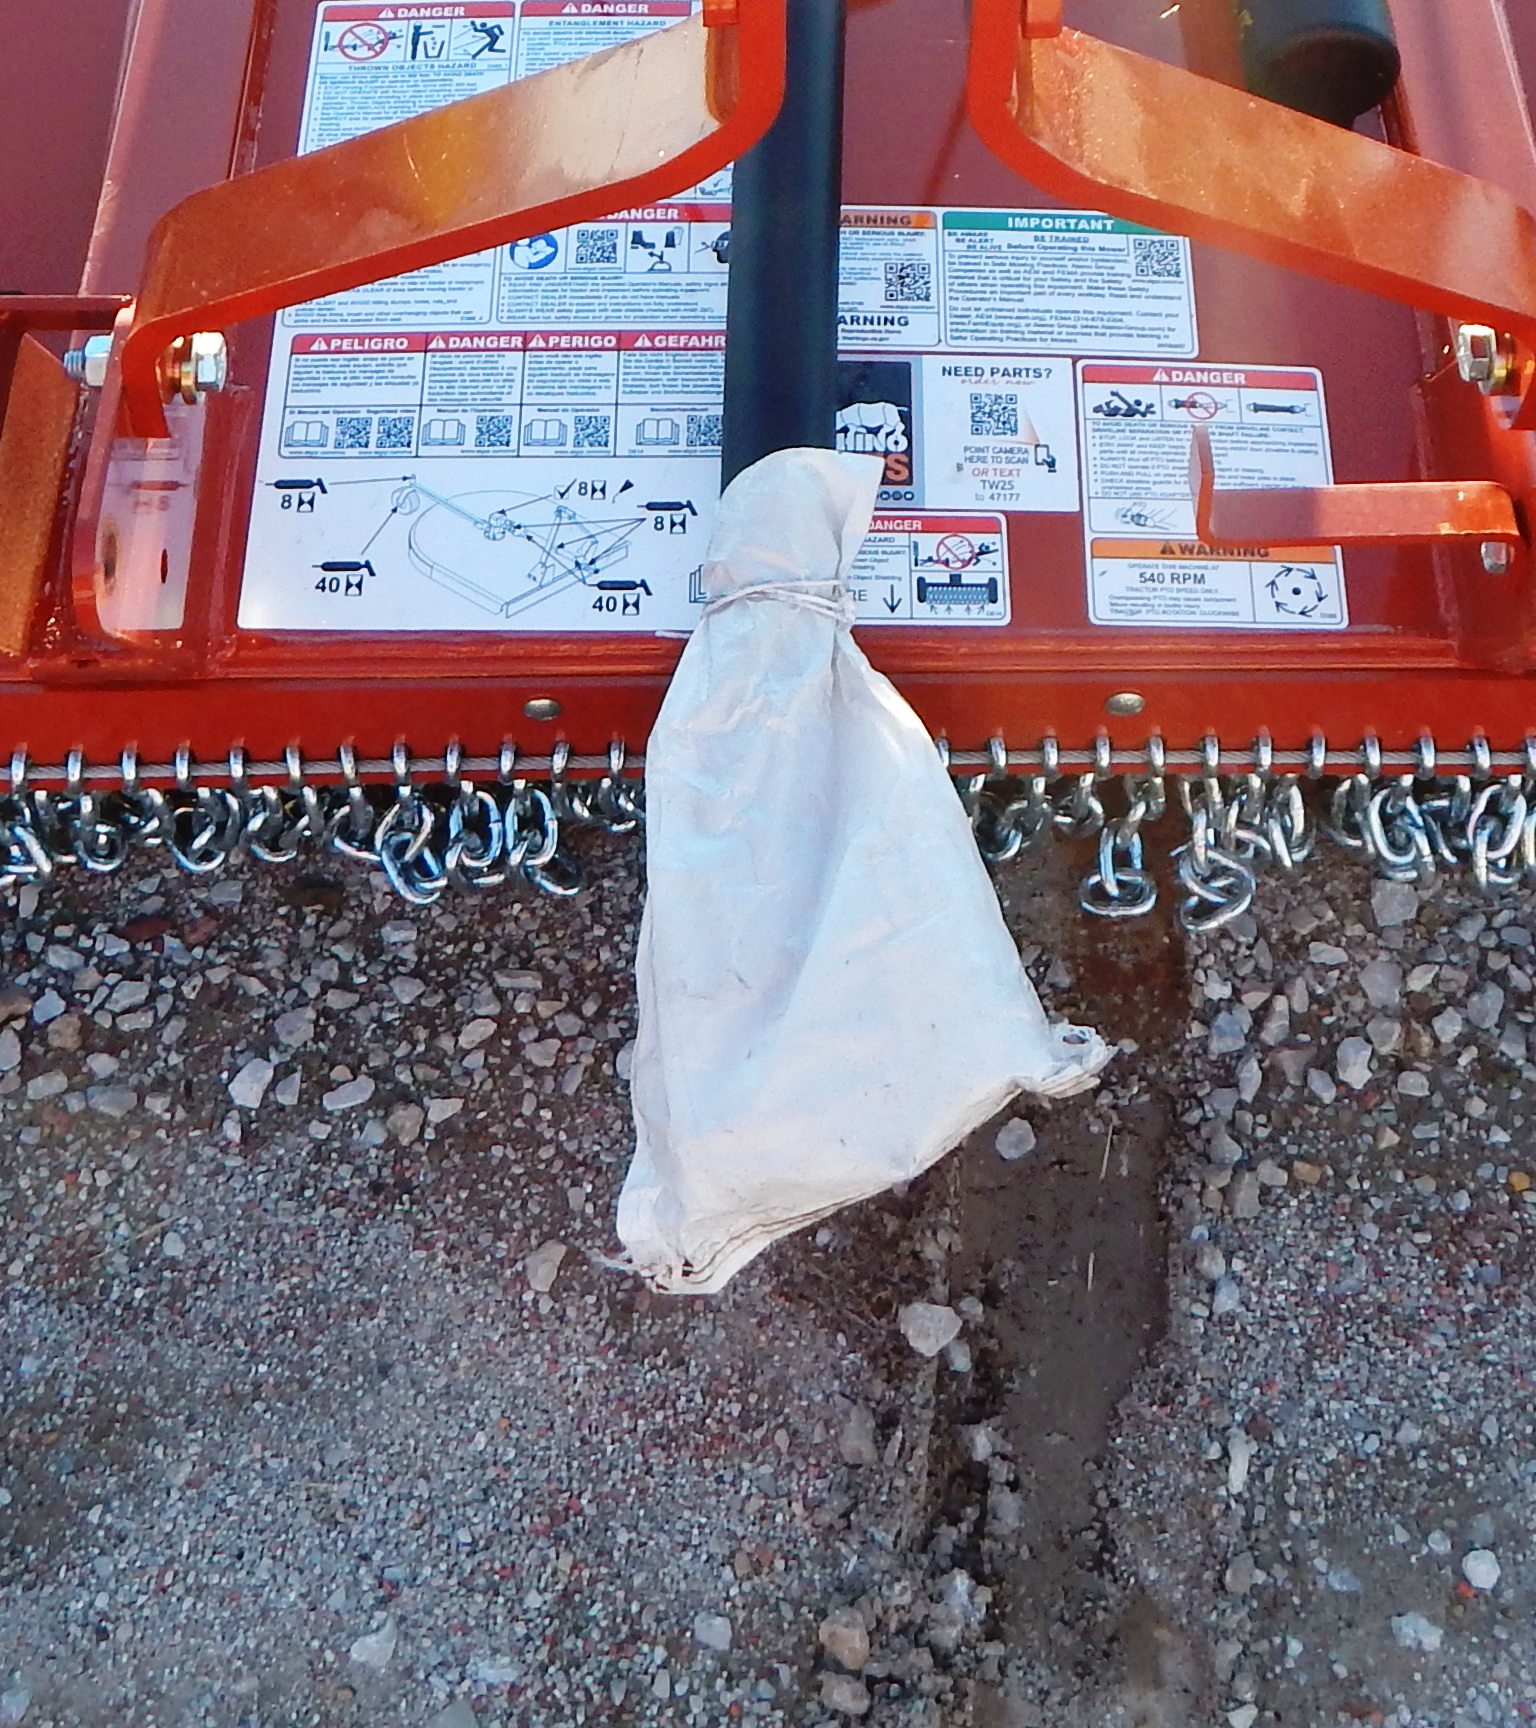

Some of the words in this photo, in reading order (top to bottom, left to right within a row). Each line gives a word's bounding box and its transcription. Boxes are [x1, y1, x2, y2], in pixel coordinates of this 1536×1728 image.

[397, 6, 465, 18] DANGER
[581, 3, 649, 14] DANGER
[840, 215, 912, 225] ARNING
[1008, 217, 1115, 230] IMPORTANT
[838, 314, 910, 326] ARNING
[330, 337, 409, 350] PELIGRO
[448, 336, 523, 348] DANGER
[548, 335, 617, 347] PERIGO
[654, 335, 726, 347] GEFAHR
[941, 365, 985, 377] NEED
[990, 367, 1053, 379] PARTS?
[1171, 370, 1246, 384] DANGER
[836, 432, 909, 452] HINO
[963, 445, 990, 454] POINT
[992, 446, 1029, 455] CAMERA
[964, 455, 987, 464] HERE
[991, 455, 1003, 464] TO
[1005, 456, 1029, 464] SCAN
[972, 467, 988, 477] OR
[993, 468, 1022, 477] TEXT
[578, 481, 588, 497] 8
[981, 479, 1015, 490] TW25
[280, 494, 292, 510] 8
[975, 493, 985, 501] to
[989, 493, 1020, 502] 47177
[654, 515, 665, 531] 8
[1139, 572, 1165, 584] 540
[1170, 573, 1206, 584] RPM
[314, 576, 340, 594] 40
[592, 595, 617, 612] 40
